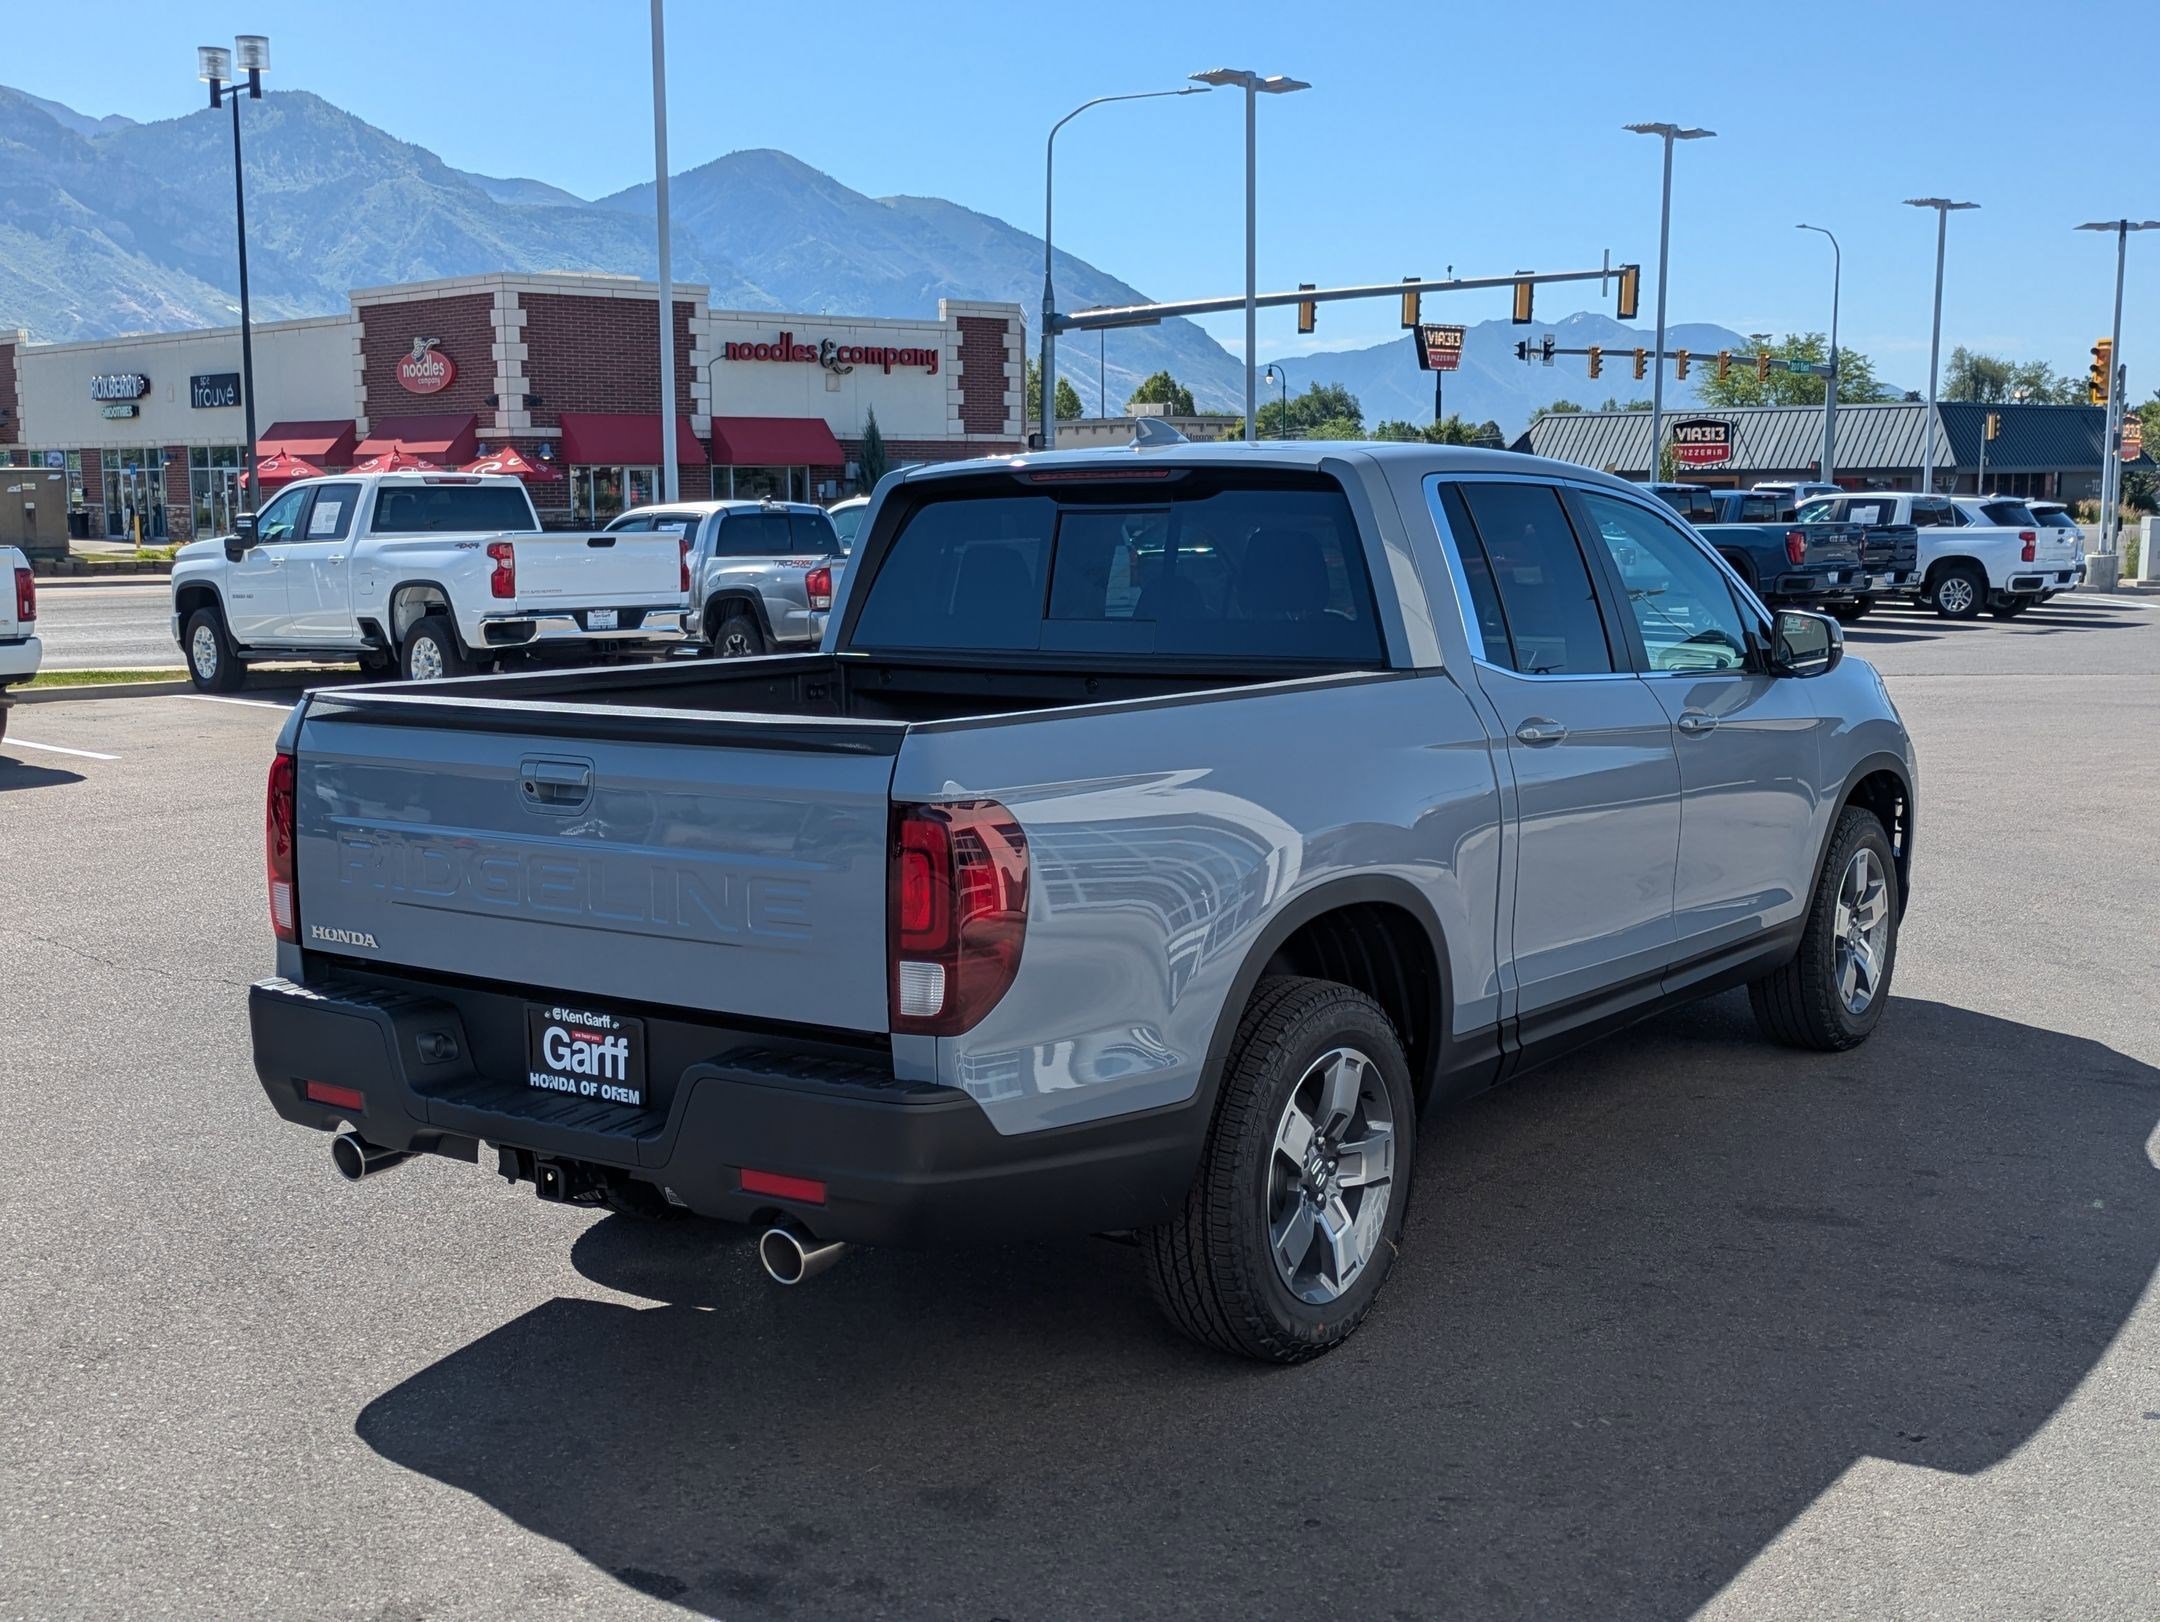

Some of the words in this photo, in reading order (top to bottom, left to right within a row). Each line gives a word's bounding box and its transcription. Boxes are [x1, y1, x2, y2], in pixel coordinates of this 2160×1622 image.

[402, 353, 445, 378] noodles
[725, 331, 818, 362] noodles
[837, 345, 939, 375] company
[90, 375, 138, 400] ROXBERRY
[1679, 448, 1723, 456] PIZZERIA
[336, 830, 813, 943] RIDGELINE
[311, 925, 379, 949] HONDA
[543, 1026, 628, 1080] Garff
[529, 1072, 577, 1093] HONDA
[580, 1081, 598, 1096] OF
[601, 1084, 640, 1105] OREM
